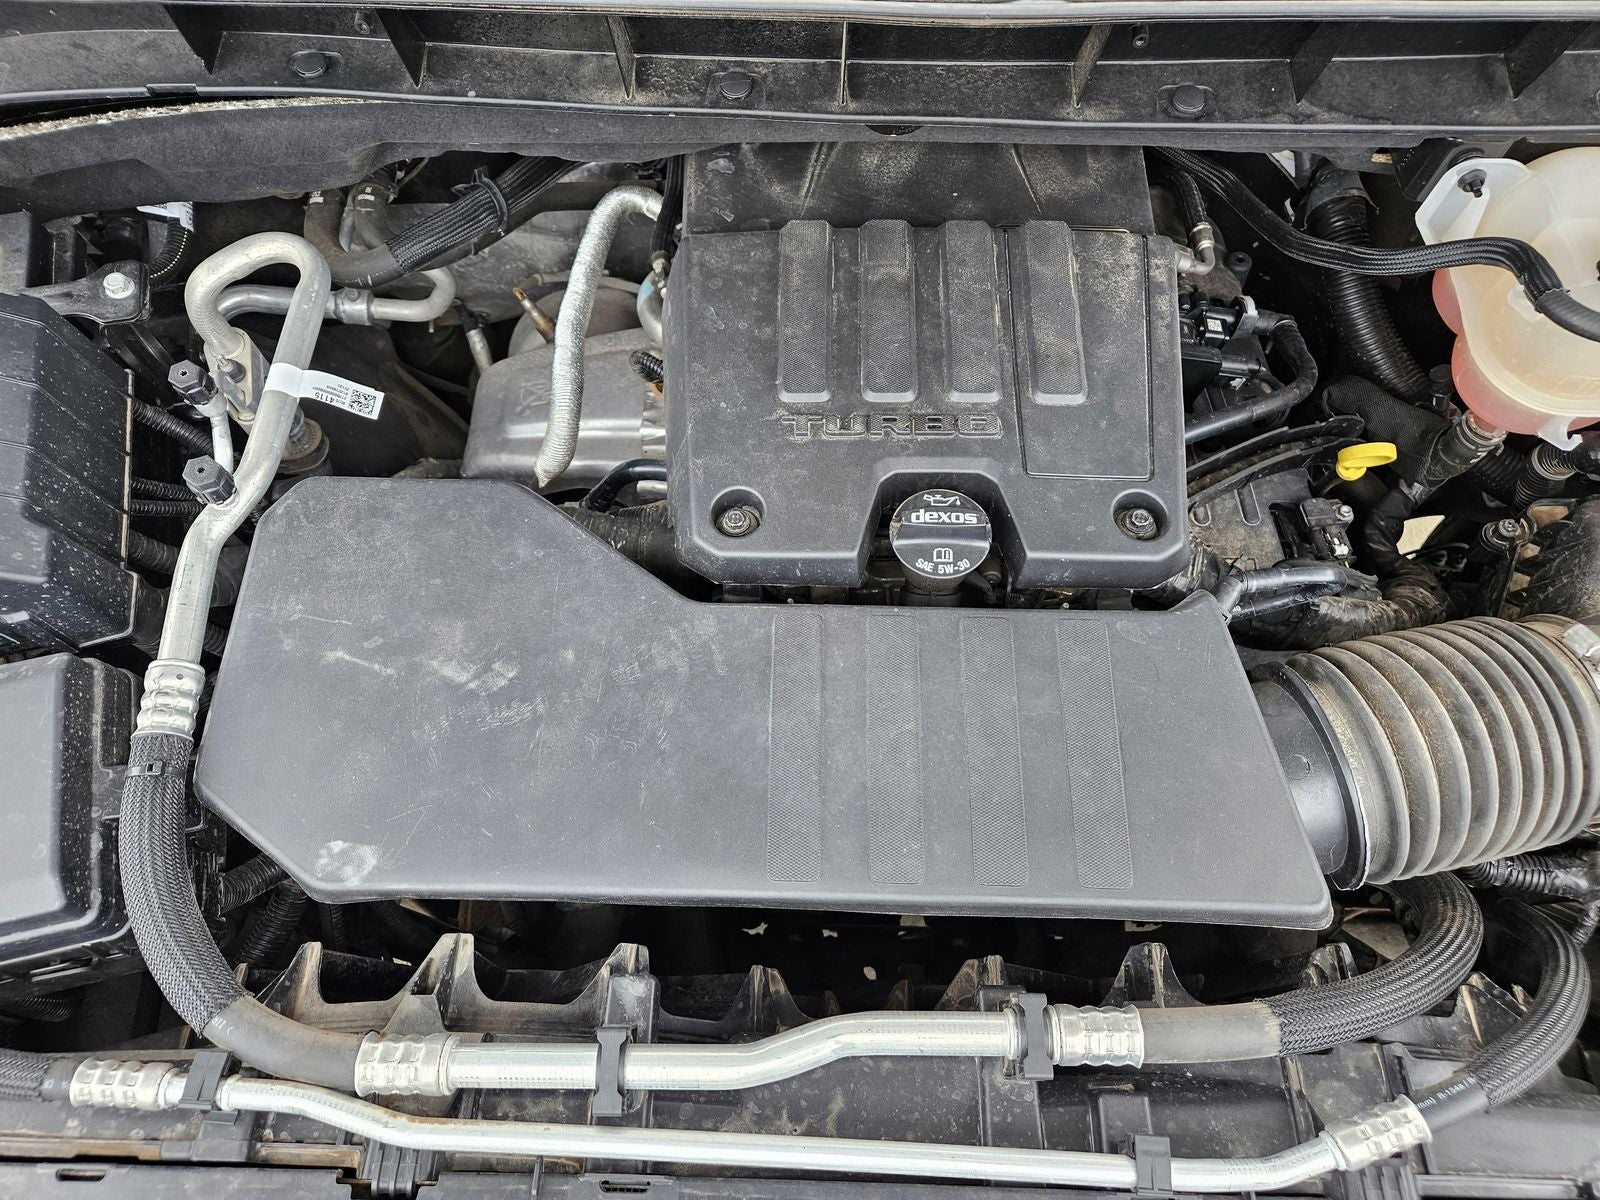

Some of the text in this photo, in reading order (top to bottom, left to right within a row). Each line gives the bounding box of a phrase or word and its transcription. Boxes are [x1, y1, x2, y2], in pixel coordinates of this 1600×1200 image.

[314, 391, 335, 404] 4115
[781, 413, 1003, 439] TURBO
[910, 508, 979, 525] dexos
[915, 558, 971, 574] SAE 5W-30
